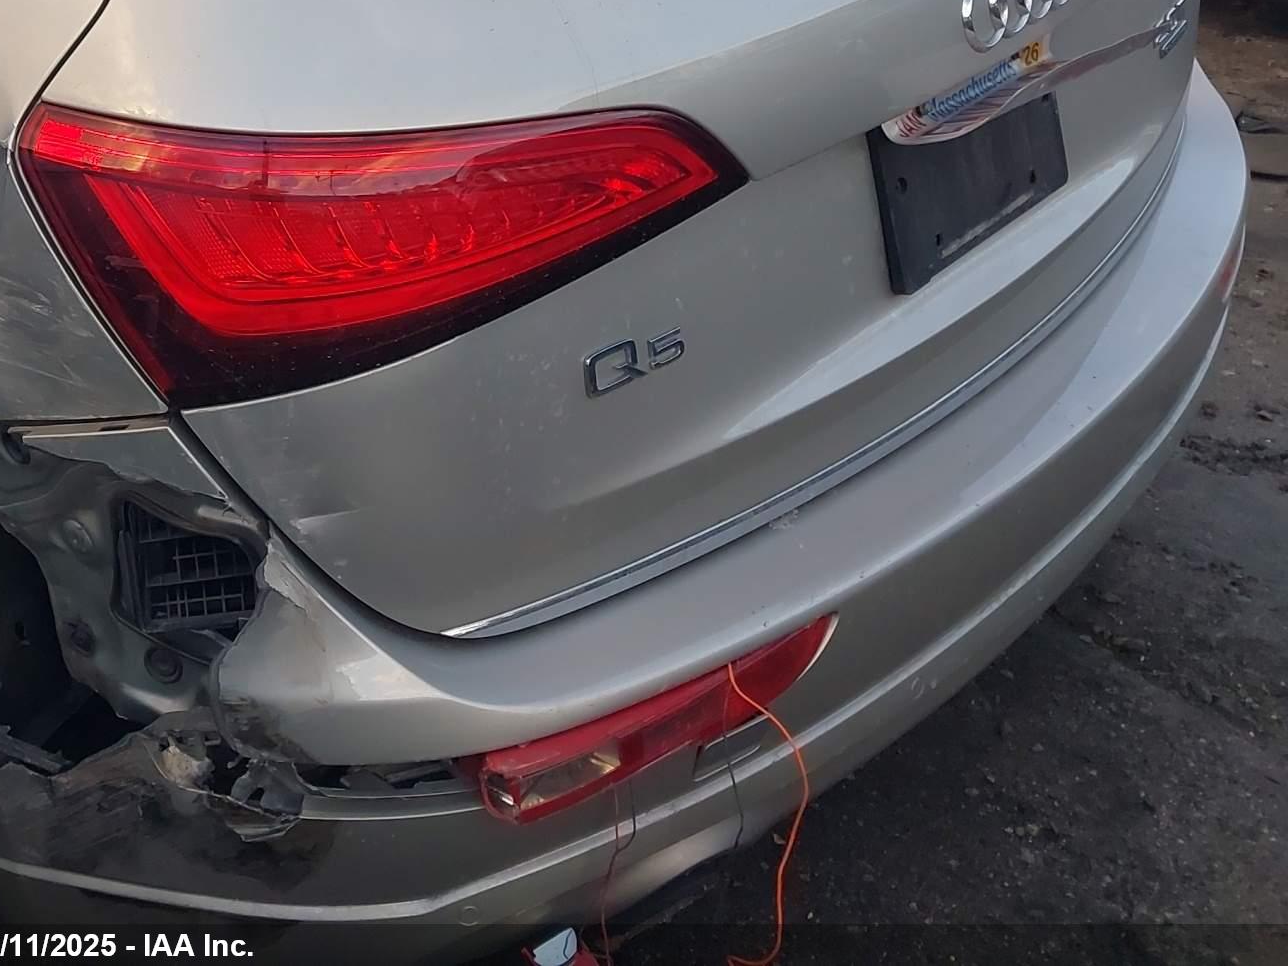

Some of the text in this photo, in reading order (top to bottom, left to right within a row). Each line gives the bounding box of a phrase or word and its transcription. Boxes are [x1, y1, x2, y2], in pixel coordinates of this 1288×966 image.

[895, 41, 1040, 138] JAN Massachusetts 26
[583, 326, 685, 399] Q5
